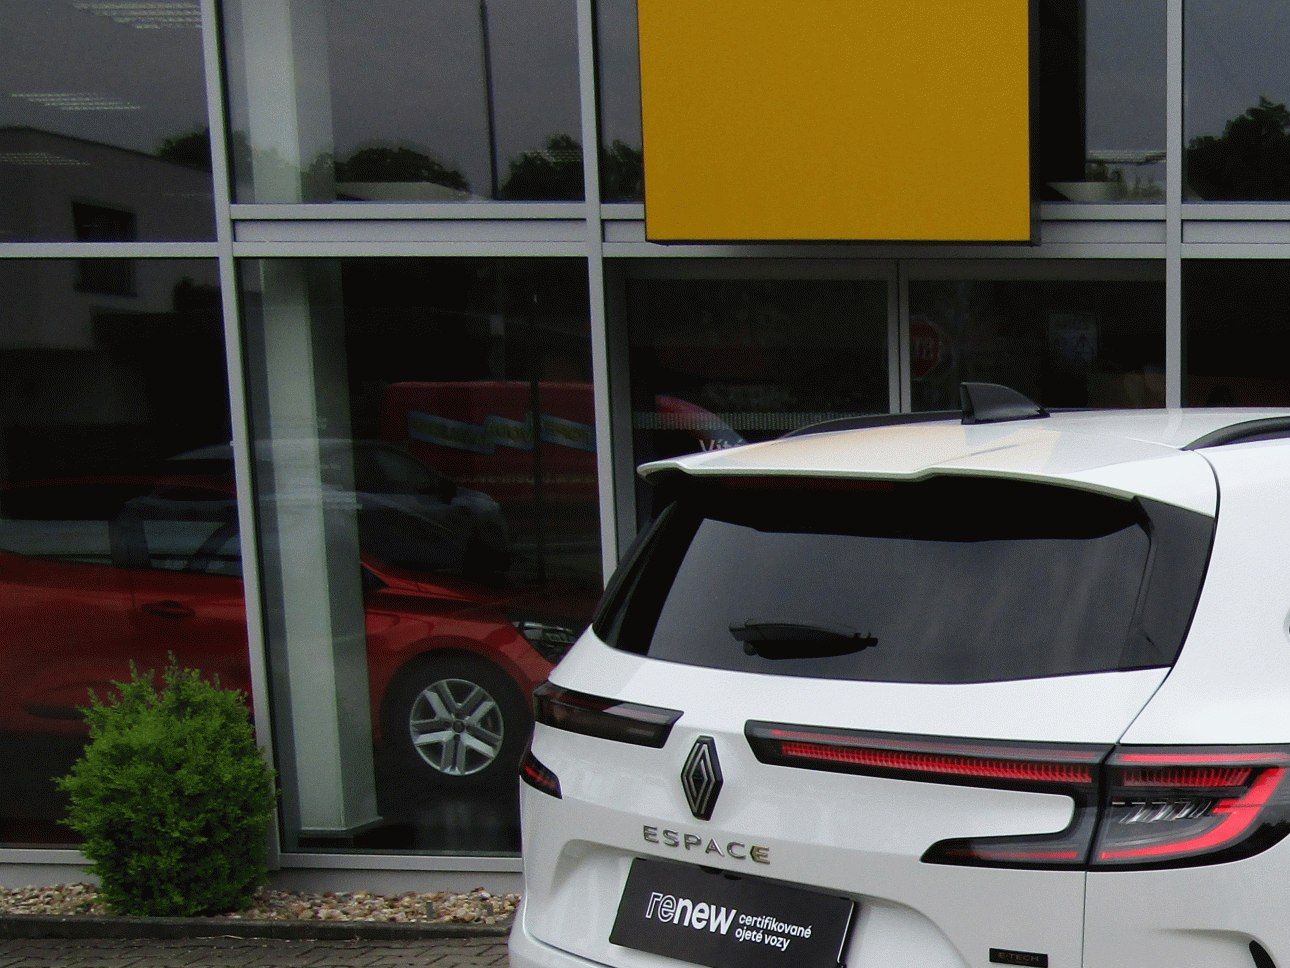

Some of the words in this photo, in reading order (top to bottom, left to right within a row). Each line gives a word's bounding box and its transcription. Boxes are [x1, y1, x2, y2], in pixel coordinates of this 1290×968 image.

[643, 825, 771, 865] ESPACE
[646, 892, 738, 936] renew
[739, 913, 812, 939] certifikované
[735, 927, 763, 942] ojeté
[764, 933, 791, 951] vozy
